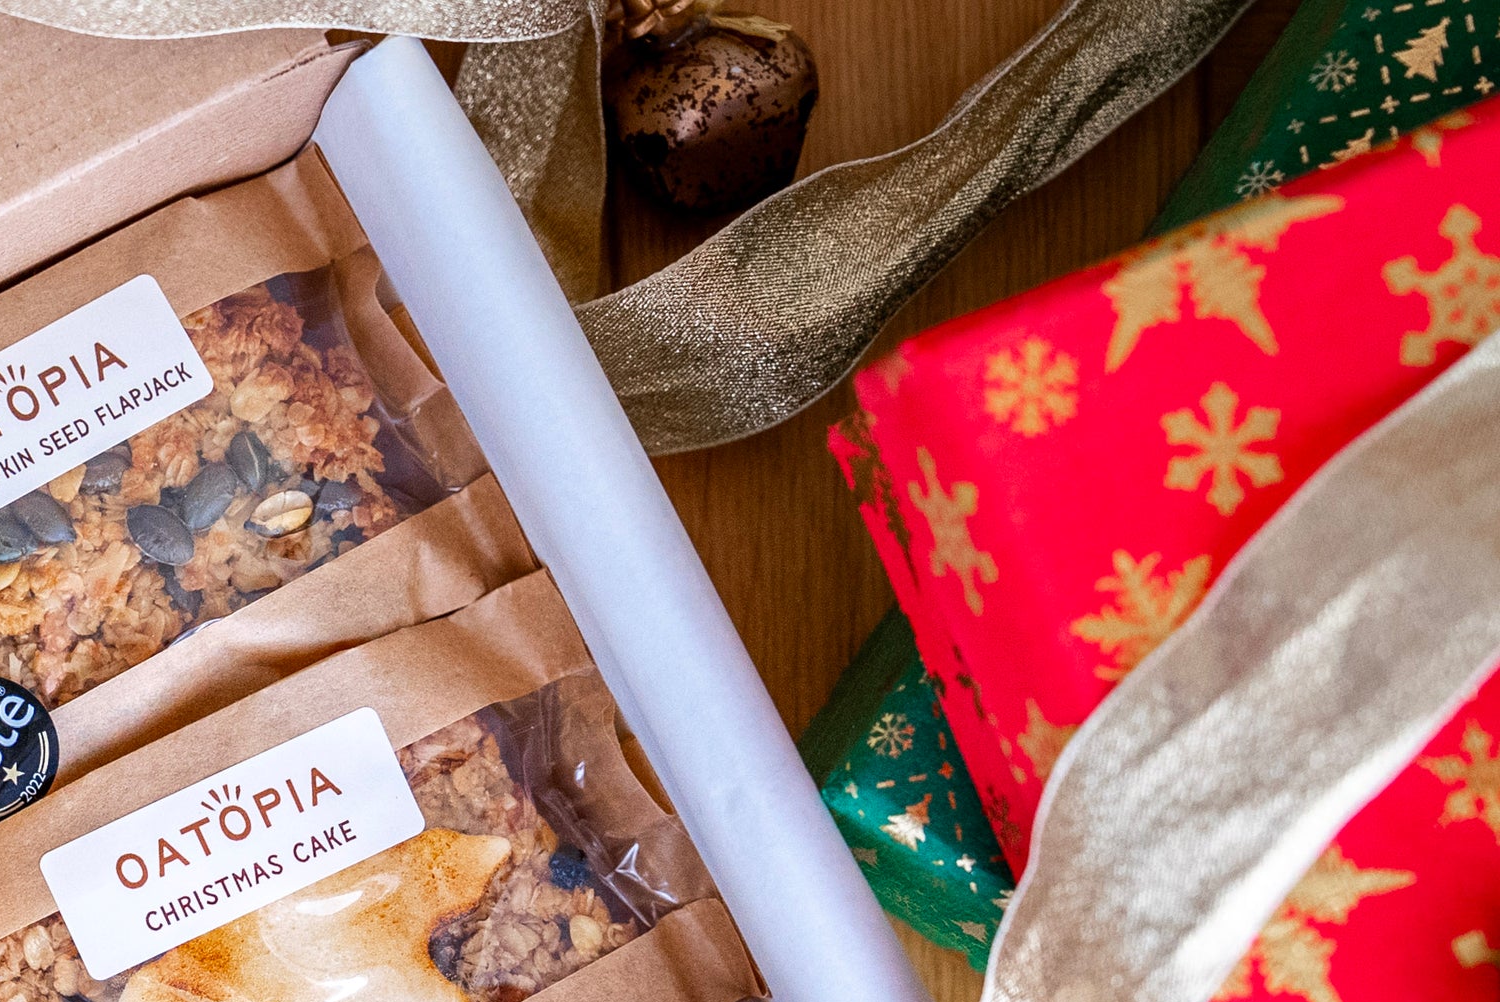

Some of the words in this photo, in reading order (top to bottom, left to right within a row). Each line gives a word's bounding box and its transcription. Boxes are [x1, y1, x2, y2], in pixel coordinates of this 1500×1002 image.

[38, 418, 90, 457] SEED
[94, 362, 193, 426] FLAPJACK
[19, 772, 47, 803] 2022
[115, 767, 343, 890] OATOPIA
[145, 854, 284, 932] CHRISTMAS
[292, 819, 358, 864] CAKE
